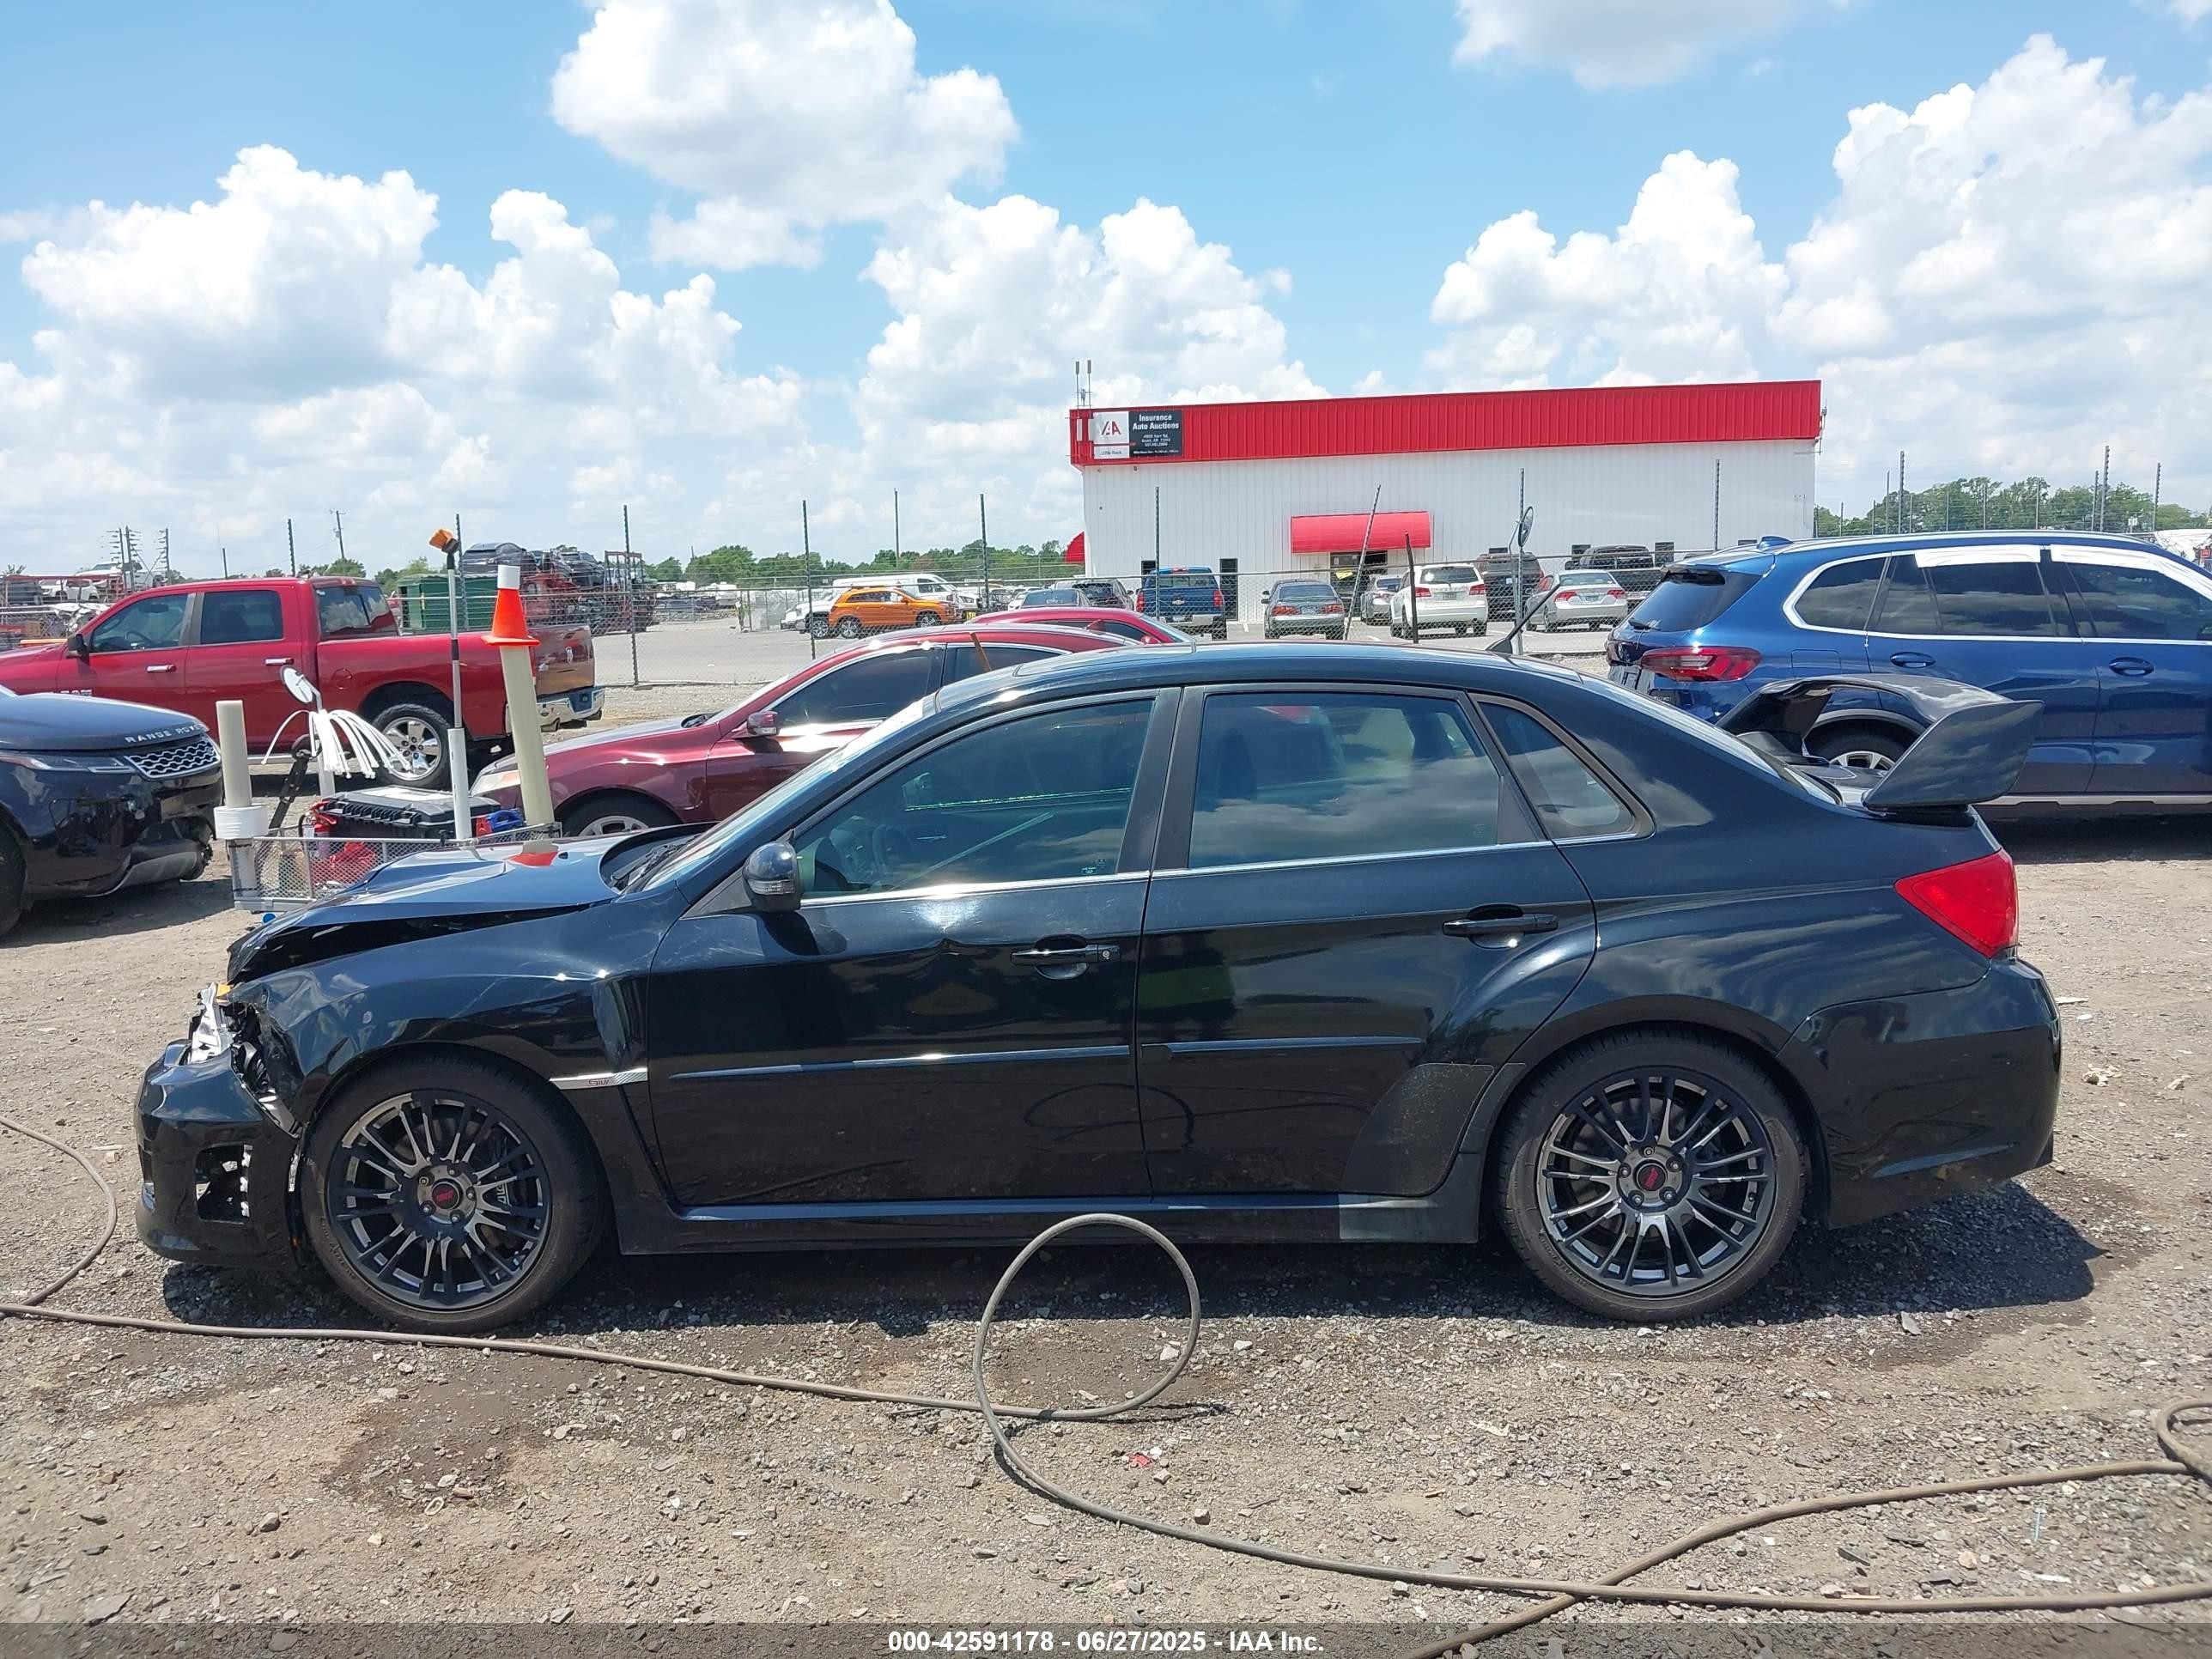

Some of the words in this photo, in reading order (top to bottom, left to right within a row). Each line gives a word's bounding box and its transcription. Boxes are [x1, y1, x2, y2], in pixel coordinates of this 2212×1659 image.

[1133, 422, 1148, 431] Auto
[125, 730, 172, 743] RANGE
[175, 725, 201, 734] ROVE
